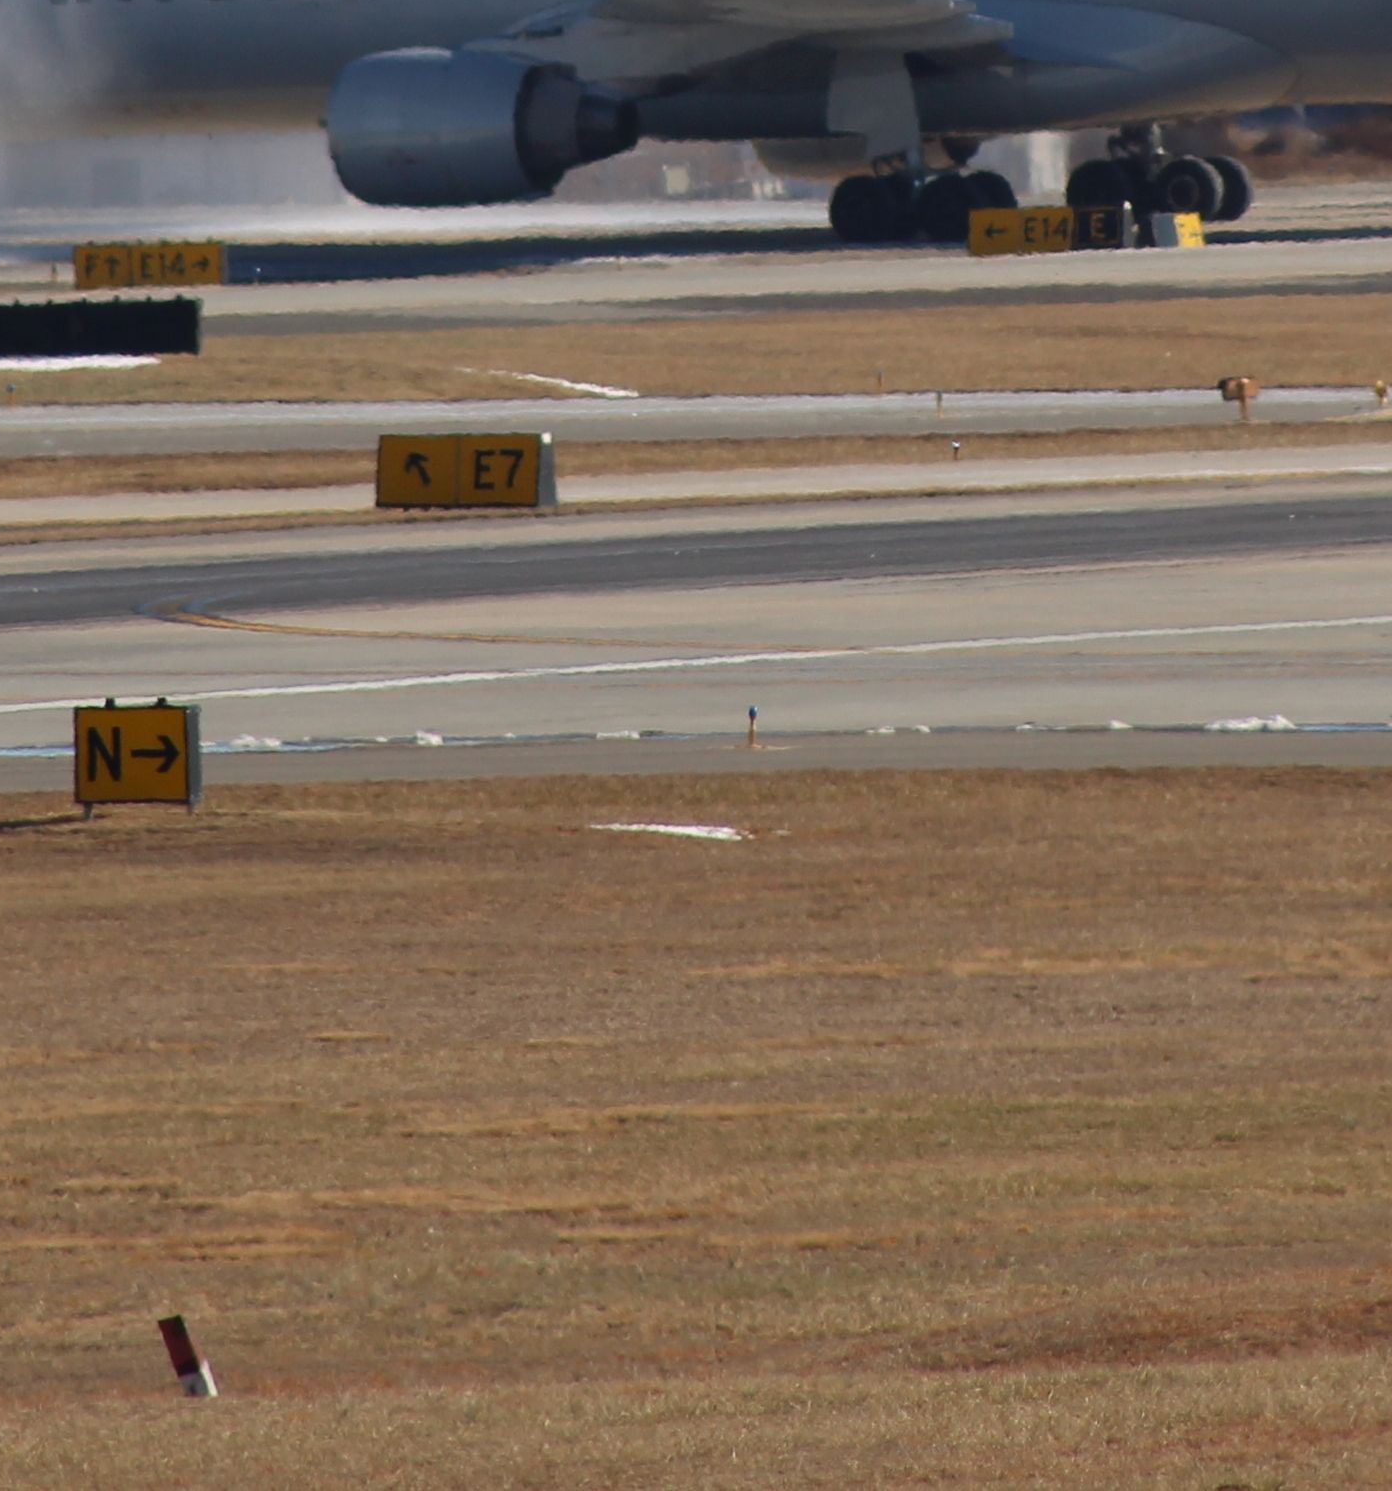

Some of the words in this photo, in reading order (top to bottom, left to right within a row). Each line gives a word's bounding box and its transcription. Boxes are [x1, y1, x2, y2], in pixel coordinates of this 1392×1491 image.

[1023, 215, 1070, 243] E14
[1090, 212, 1106, 239] E
[140, 252, 186, 280] E14
[474, 449, 525, 490] E7
[87, 726, 123, 782] N
